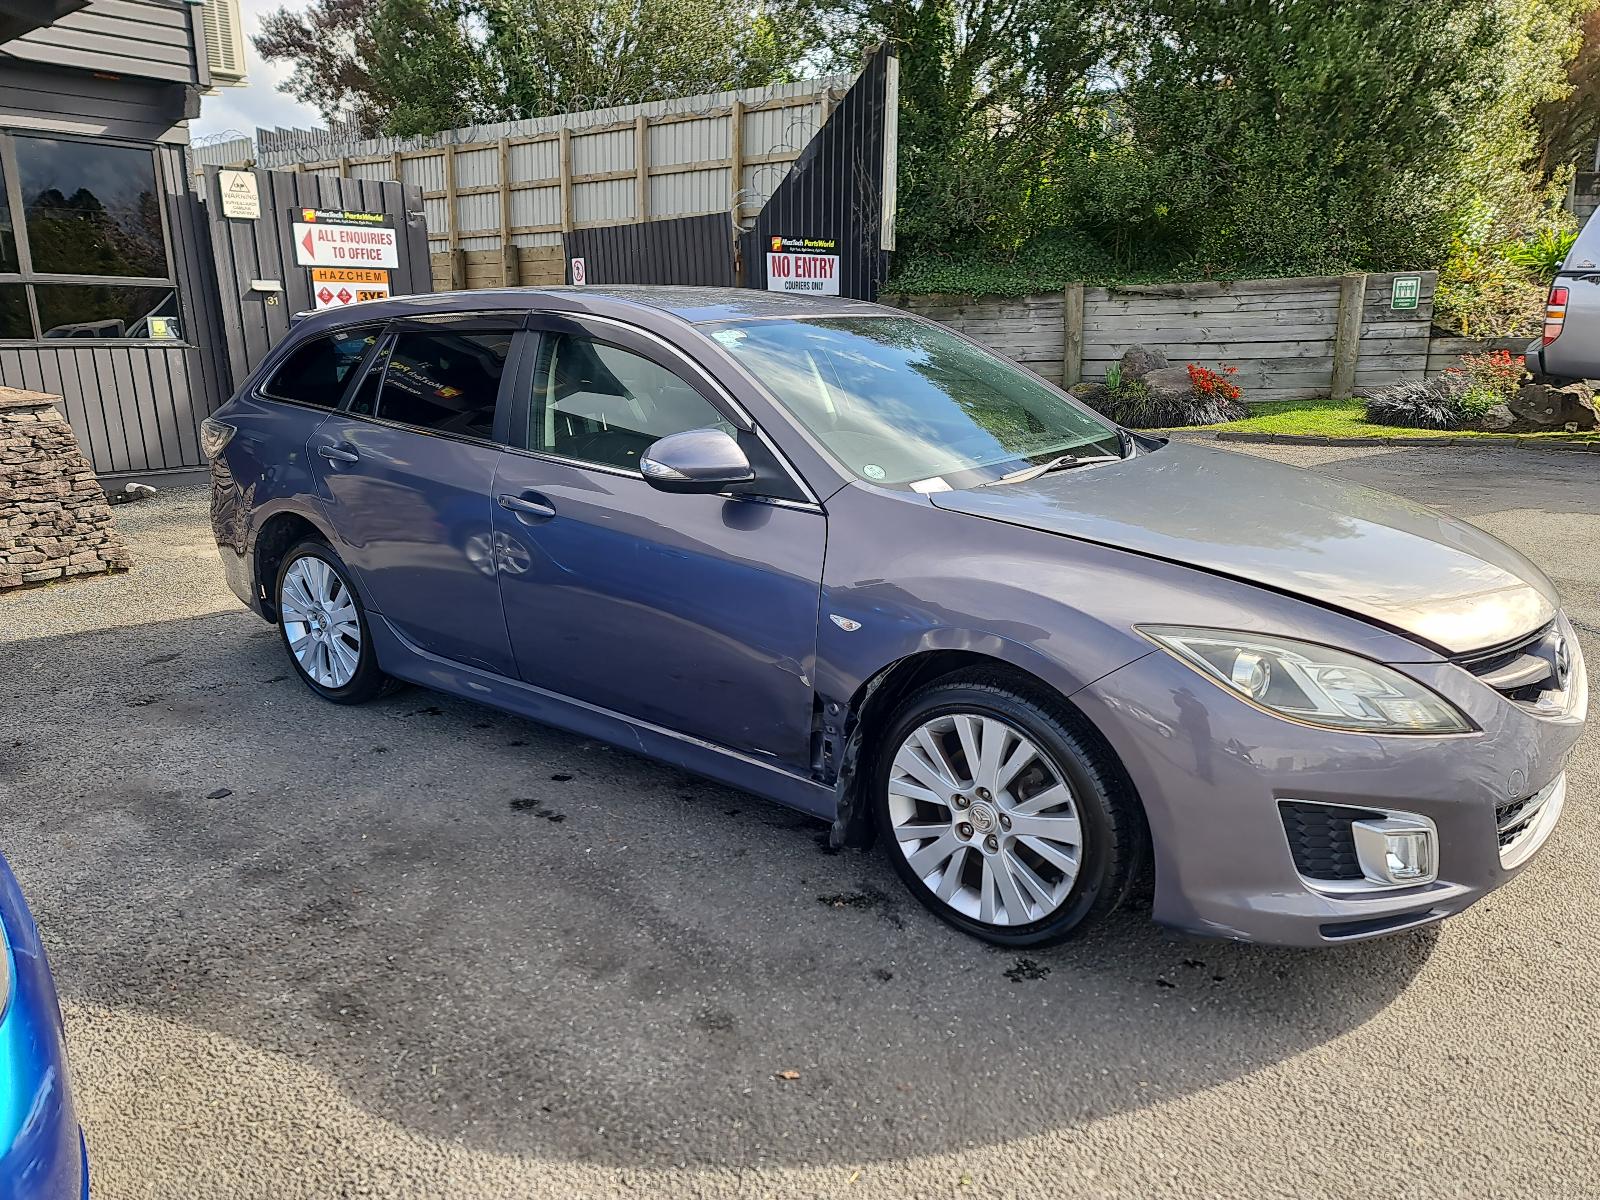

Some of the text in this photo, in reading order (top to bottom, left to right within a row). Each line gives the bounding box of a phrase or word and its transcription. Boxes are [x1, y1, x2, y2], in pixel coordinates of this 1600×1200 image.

[224, 192, 257, 201] WARNING
[344, 212, 384, 221] PartsWorld
[318, 229, 393, 246] ALL ENQUIRIES
[804, 239, 835, 248] PartsWorld
[332, 246, 383, 261] TO OFFICE
[771, 255, 835, 279] NO ENTRY
[319, 270, 382, 281] HAZCHEM
[784, 280, 824, 291] COURIERS ONLY
[267, 296, 279, 305] 31
